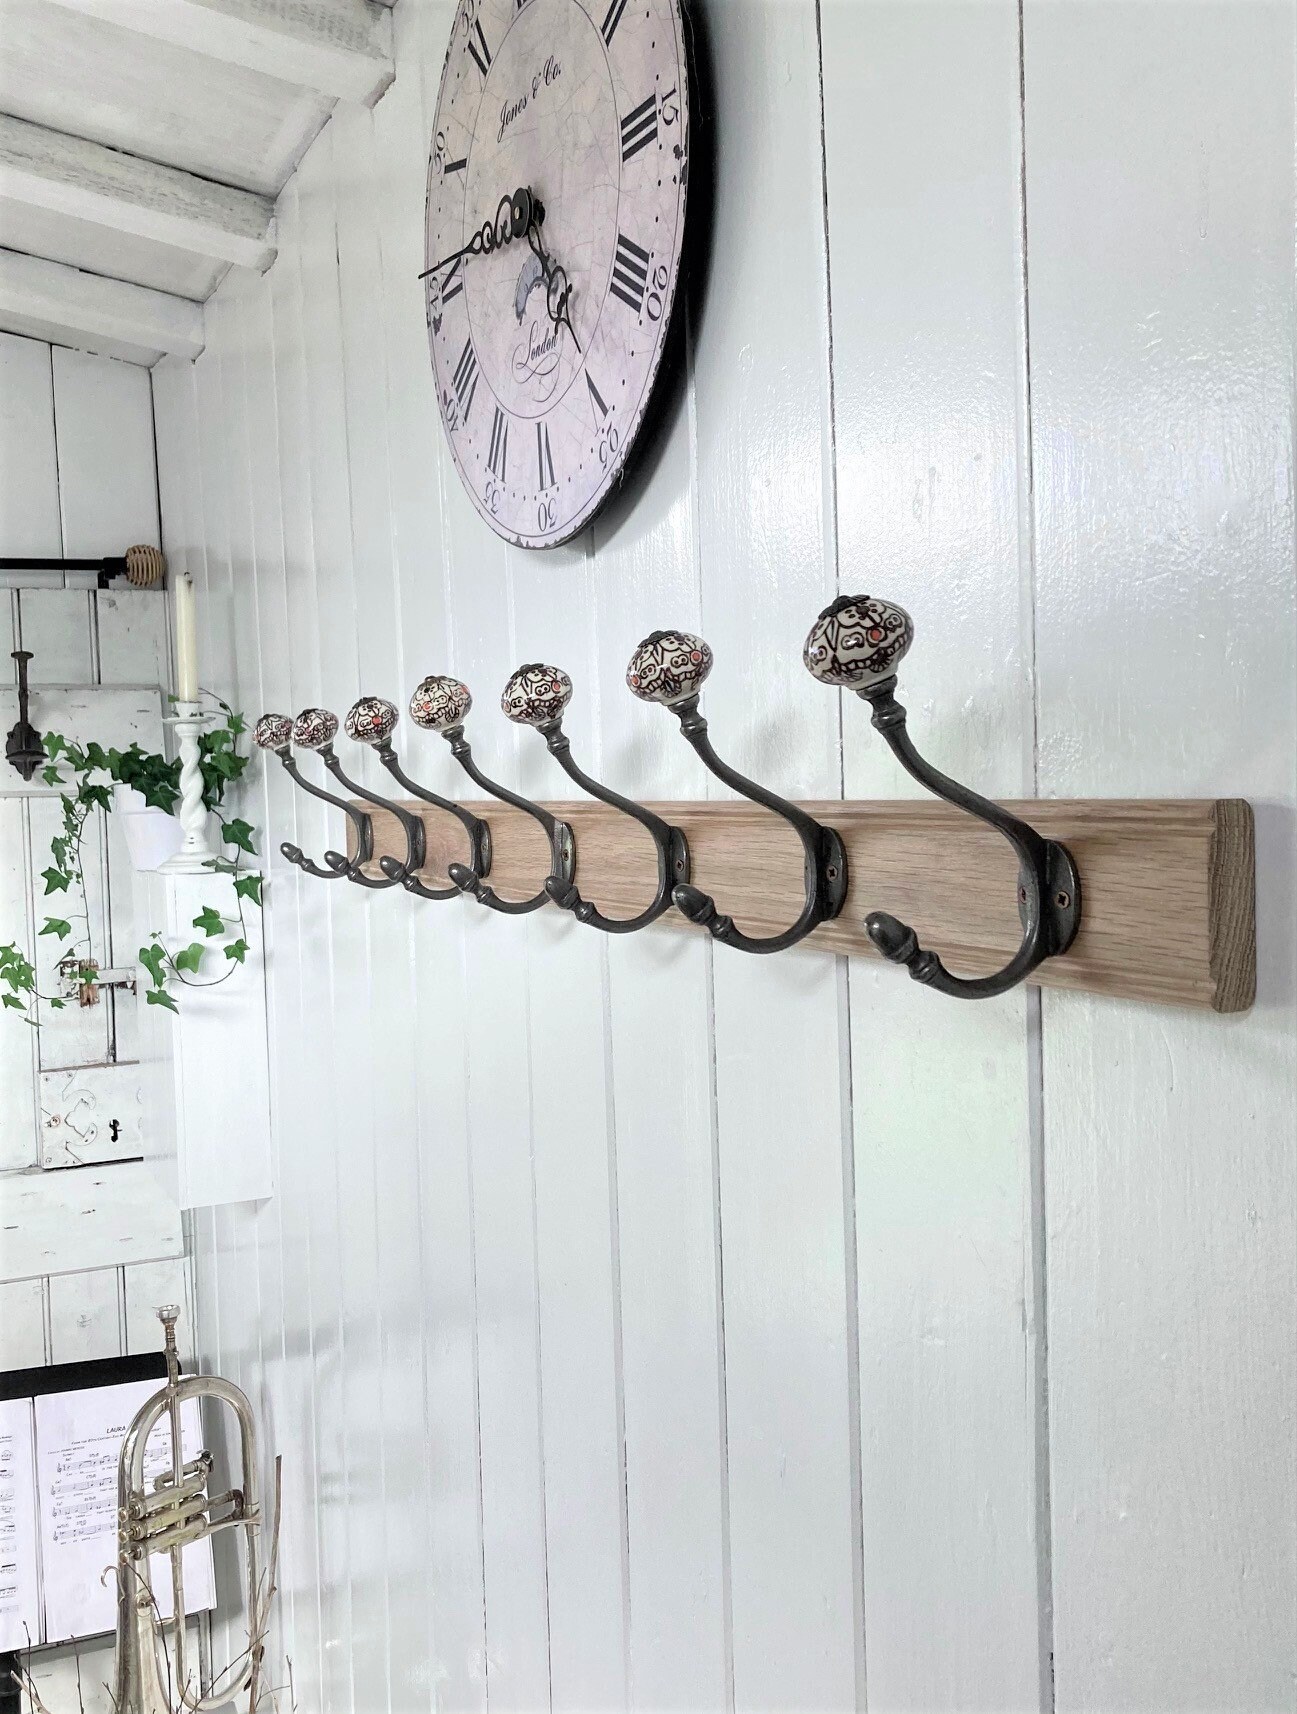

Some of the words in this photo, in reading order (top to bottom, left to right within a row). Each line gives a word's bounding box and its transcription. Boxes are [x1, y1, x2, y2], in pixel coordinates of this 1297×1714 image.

[497, 94, 529, 144] Jones
[660, 81, 679, 127] 15
[646, 265, 668, 322] 20
[599, 421, 619, 474] 25
[537, 498, 558, 533] 30
